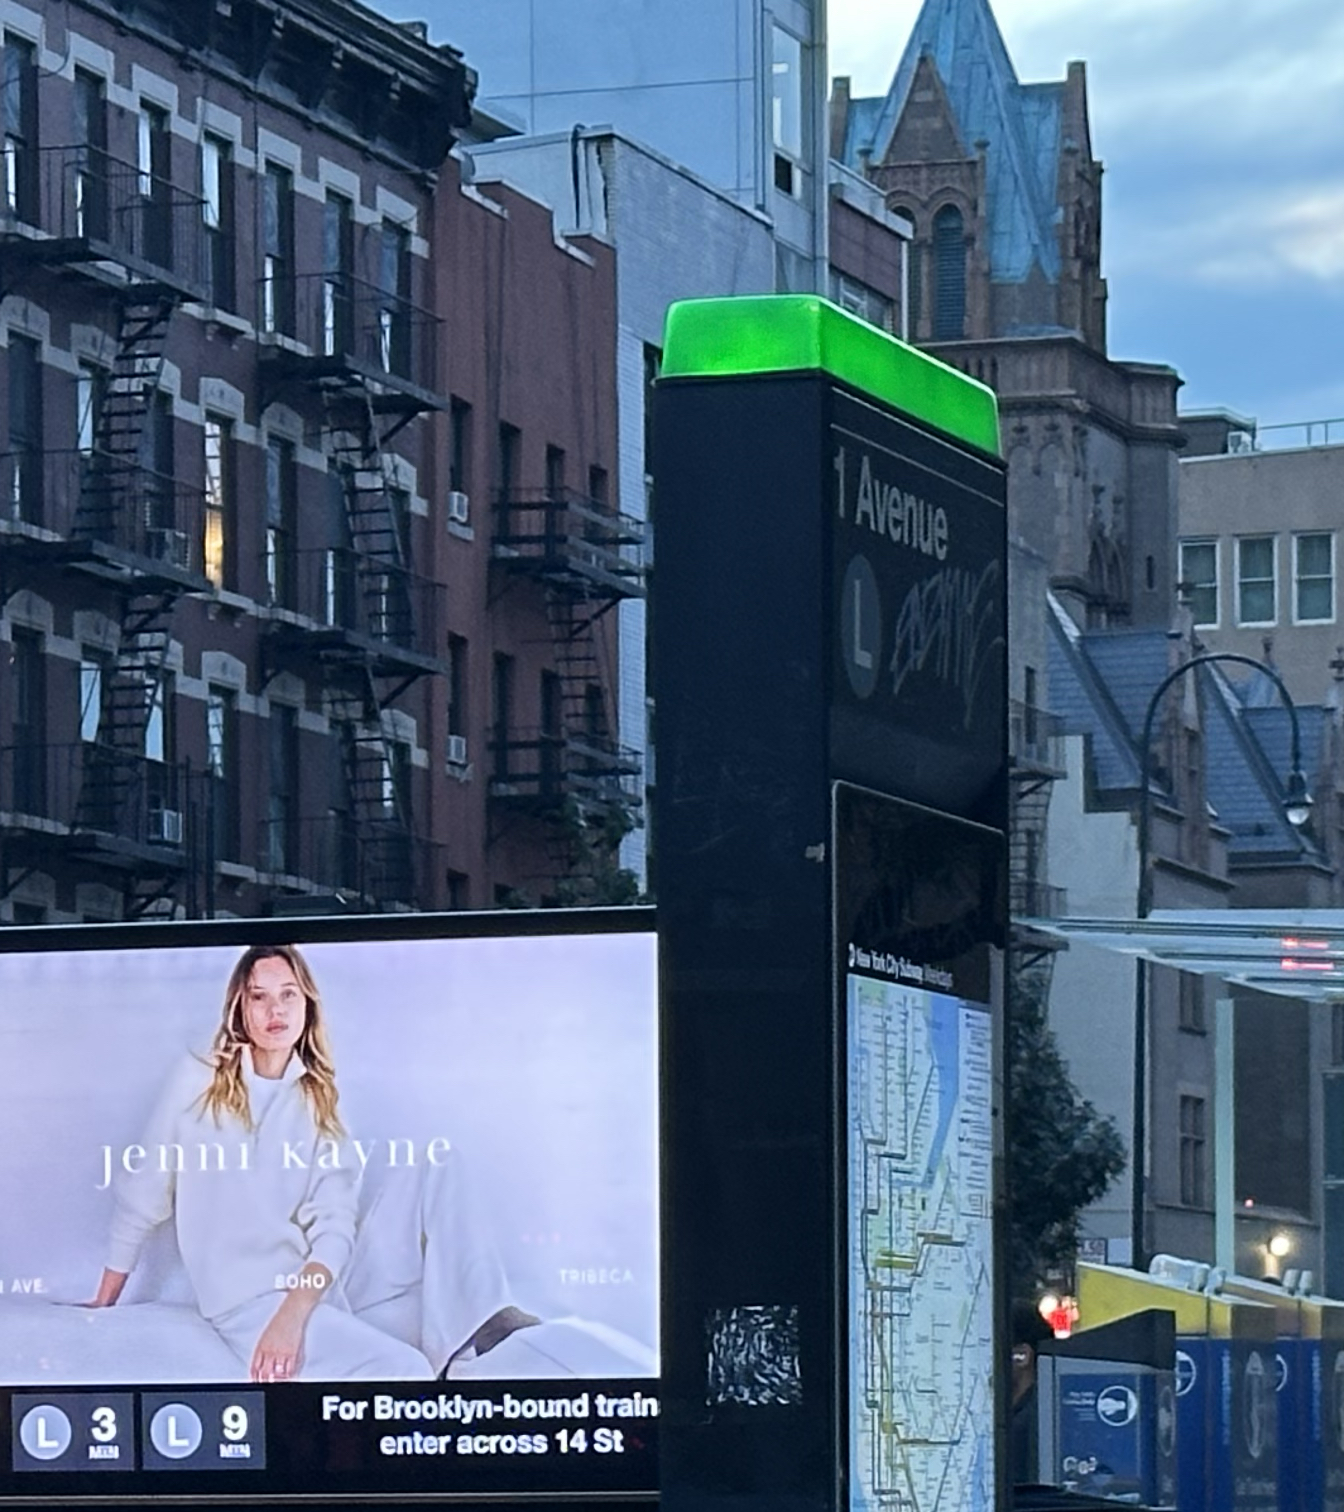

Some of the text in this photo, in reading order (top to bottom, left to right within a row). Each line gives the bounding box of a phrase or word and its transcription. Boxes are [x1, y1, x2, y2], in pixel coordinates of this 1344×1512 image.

[833, 446, 948, 560] 1 Avenue
[96, 1135, 452, 1190] jenni kayne
[274, 1273, 326, 1290] SOHO
[559, 1268, 634, 1284] TRIBECA
[91, 1406, 117, 1442] 3
[222, 1405, 248, 1440] 9
[322, 1391, 660, 1424] For Brooklyn-bound train
[380, 1427, 625, 1456] enter across 14 St
